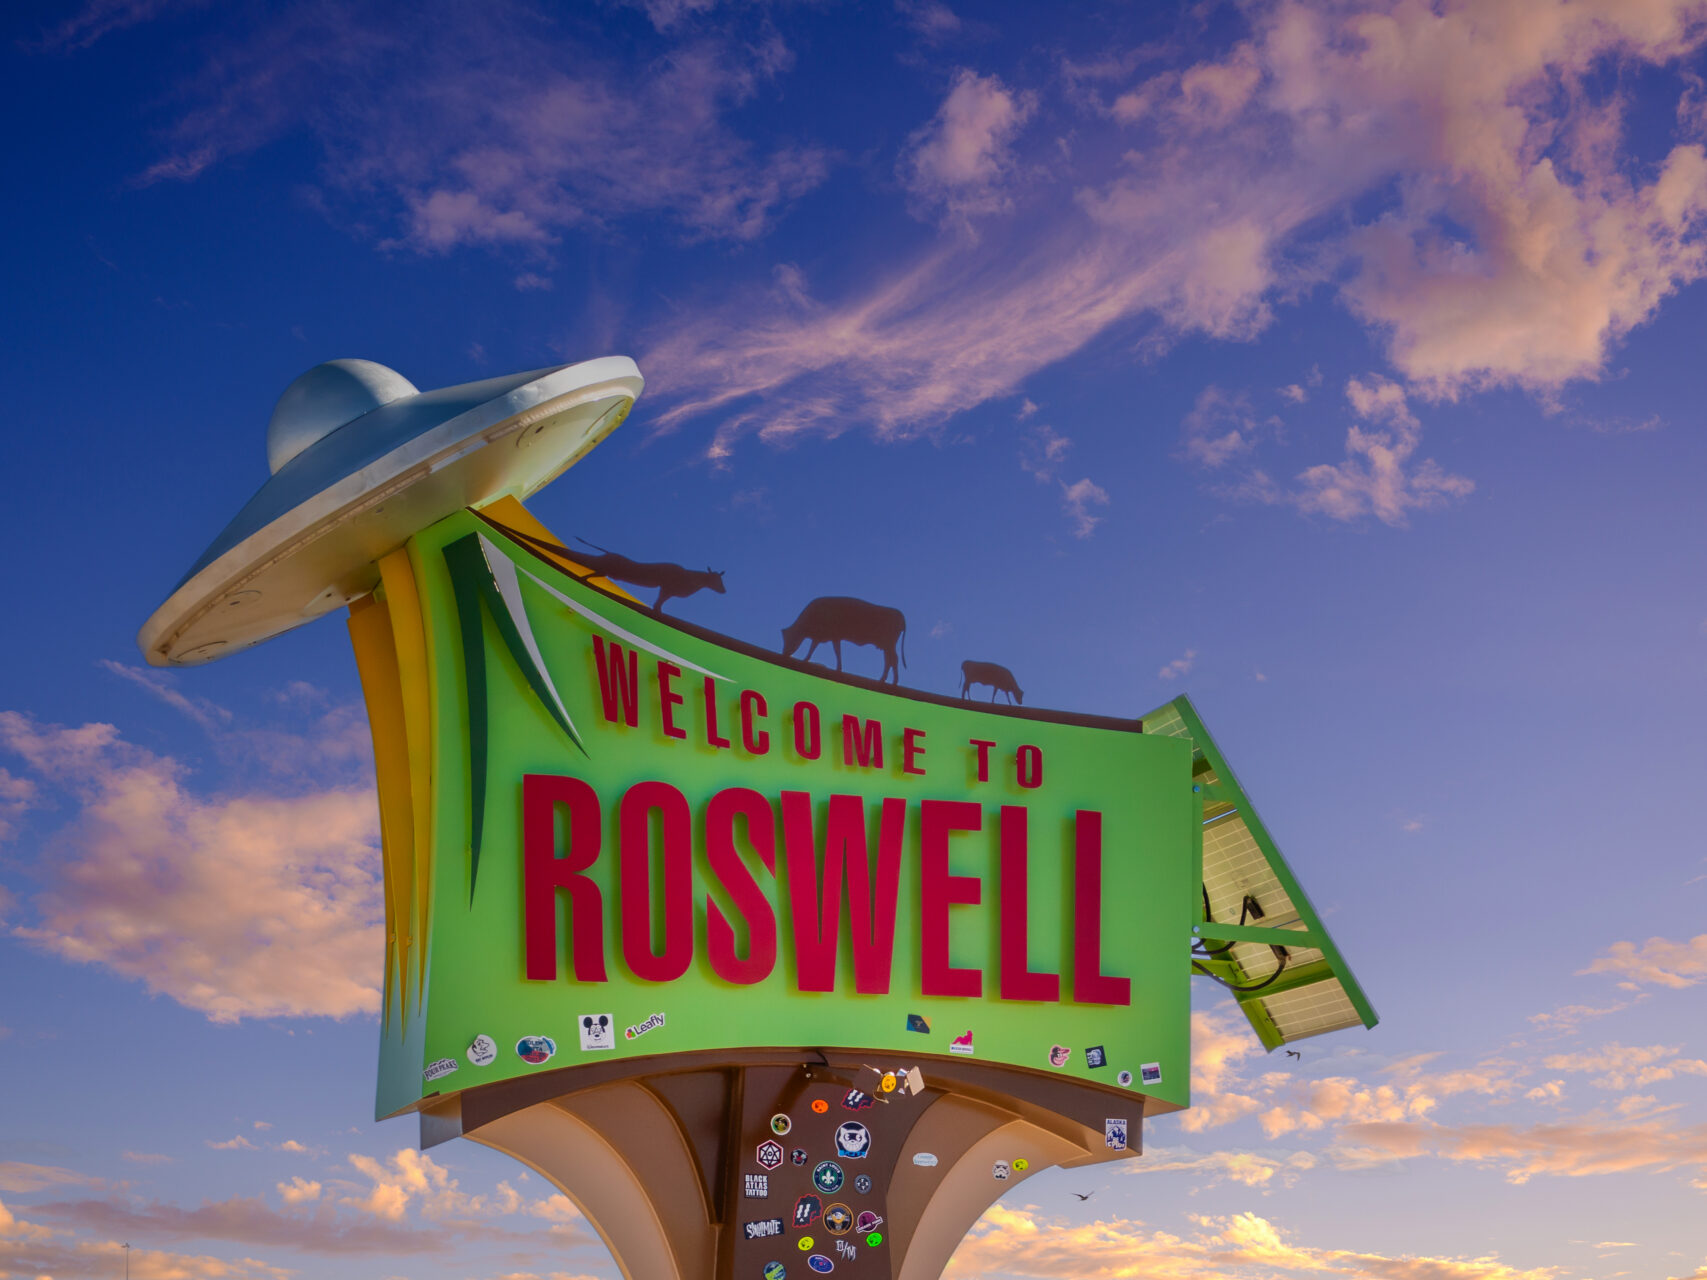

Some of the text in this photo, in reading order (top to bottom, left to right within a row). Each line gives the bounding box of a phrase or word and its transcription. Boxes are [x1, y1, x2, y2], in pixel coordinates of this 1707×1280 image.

[592, 633, 1043, 789] WELCOME TO
[522, 773, 1132, 1007] ROSWELL
[633, 1014, 665, 1036] Leafly
[745, 1174, 768, 1182] BLACK
[745, 1182, 768, 1190] ATLAS
[745, 1189, 768, 1197] TATTOO
